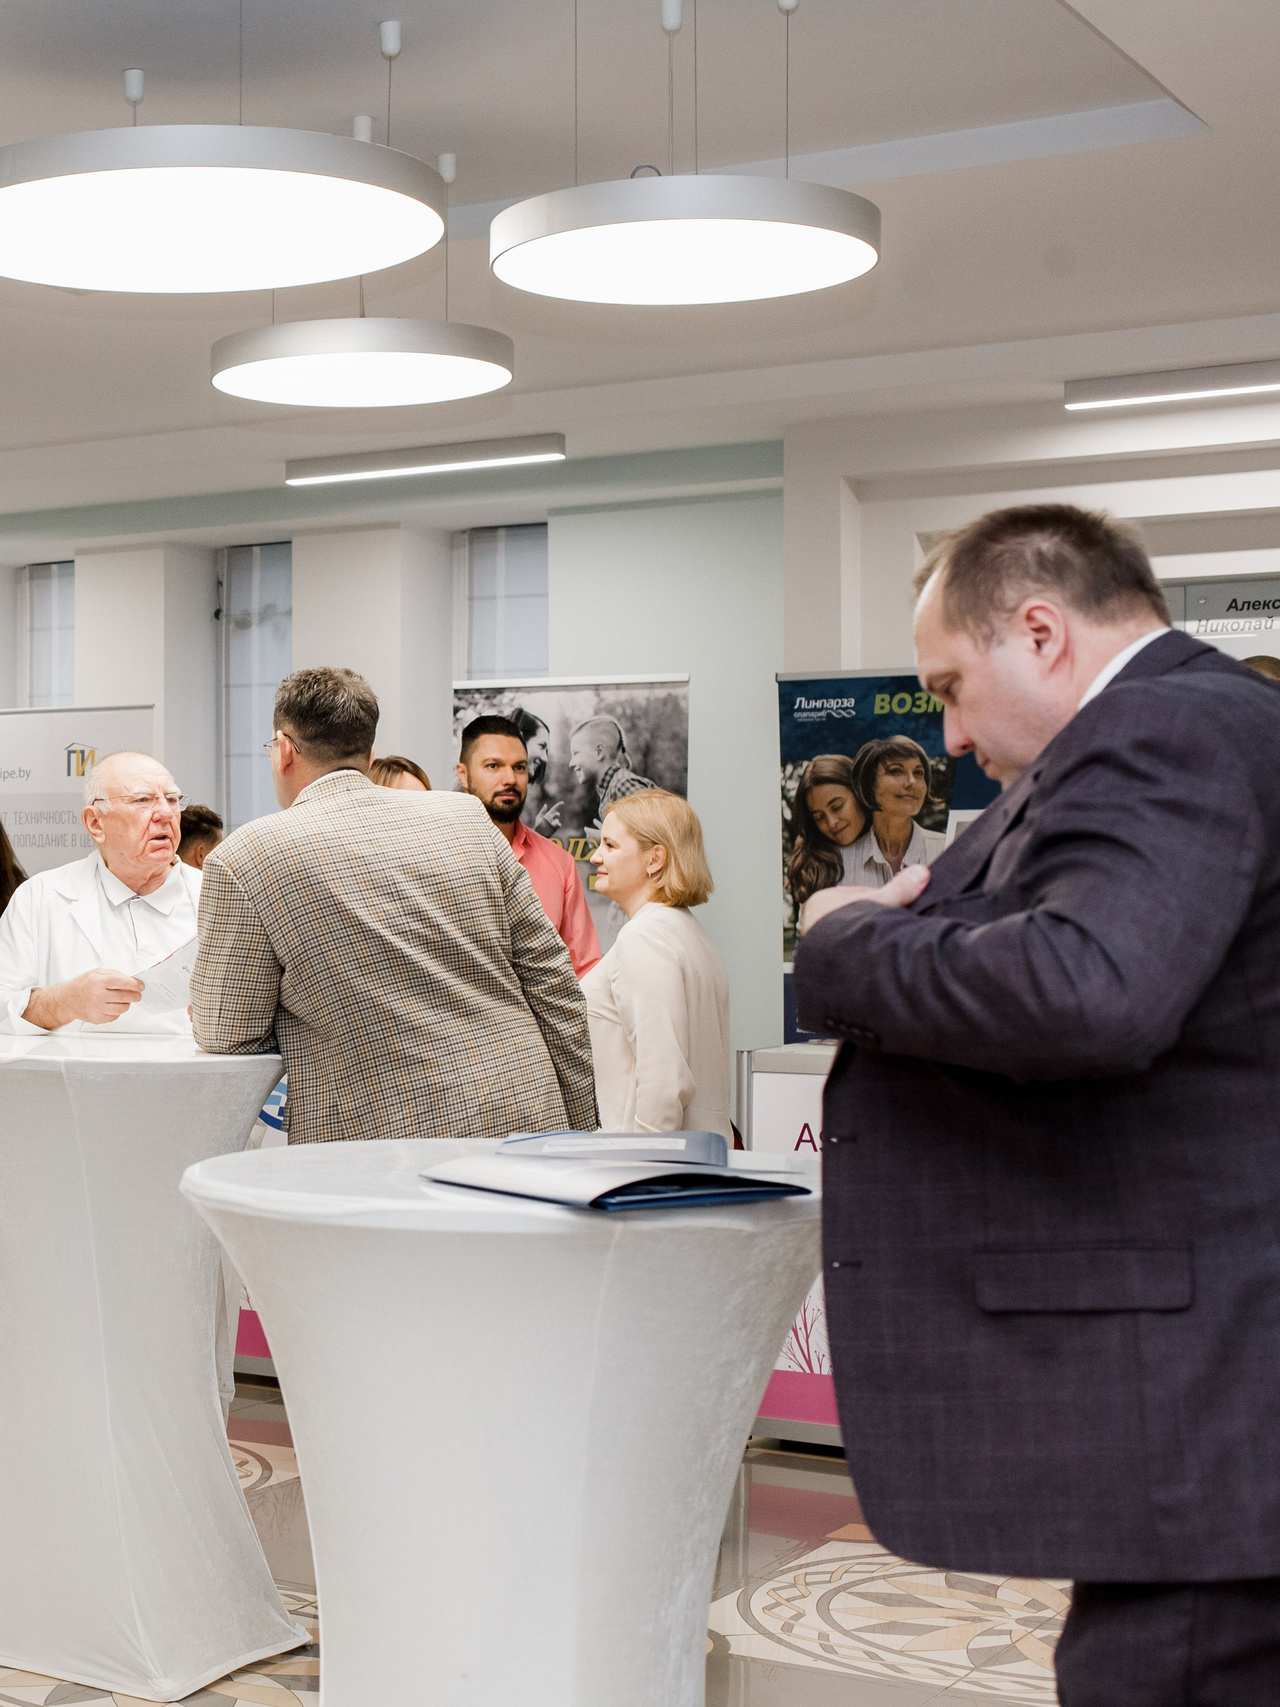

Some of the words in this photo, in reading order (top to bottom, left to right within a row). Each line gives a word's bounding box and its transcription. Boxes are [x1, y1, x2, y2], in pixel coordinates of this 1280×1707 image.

[1226, 597, 1280, 613] Алекс
[1196, 615, 1275, 634] Николай
[793, 697, 855, 711] Линпарза
[13, 810, 81, 826] ТЕХНИЧНОСТЬ,
[13, 833, 69, 849] ПОПАДАНИЕ
[71, 833, 78, 848] В
[80, 833, 97, 849] ЦЕ
